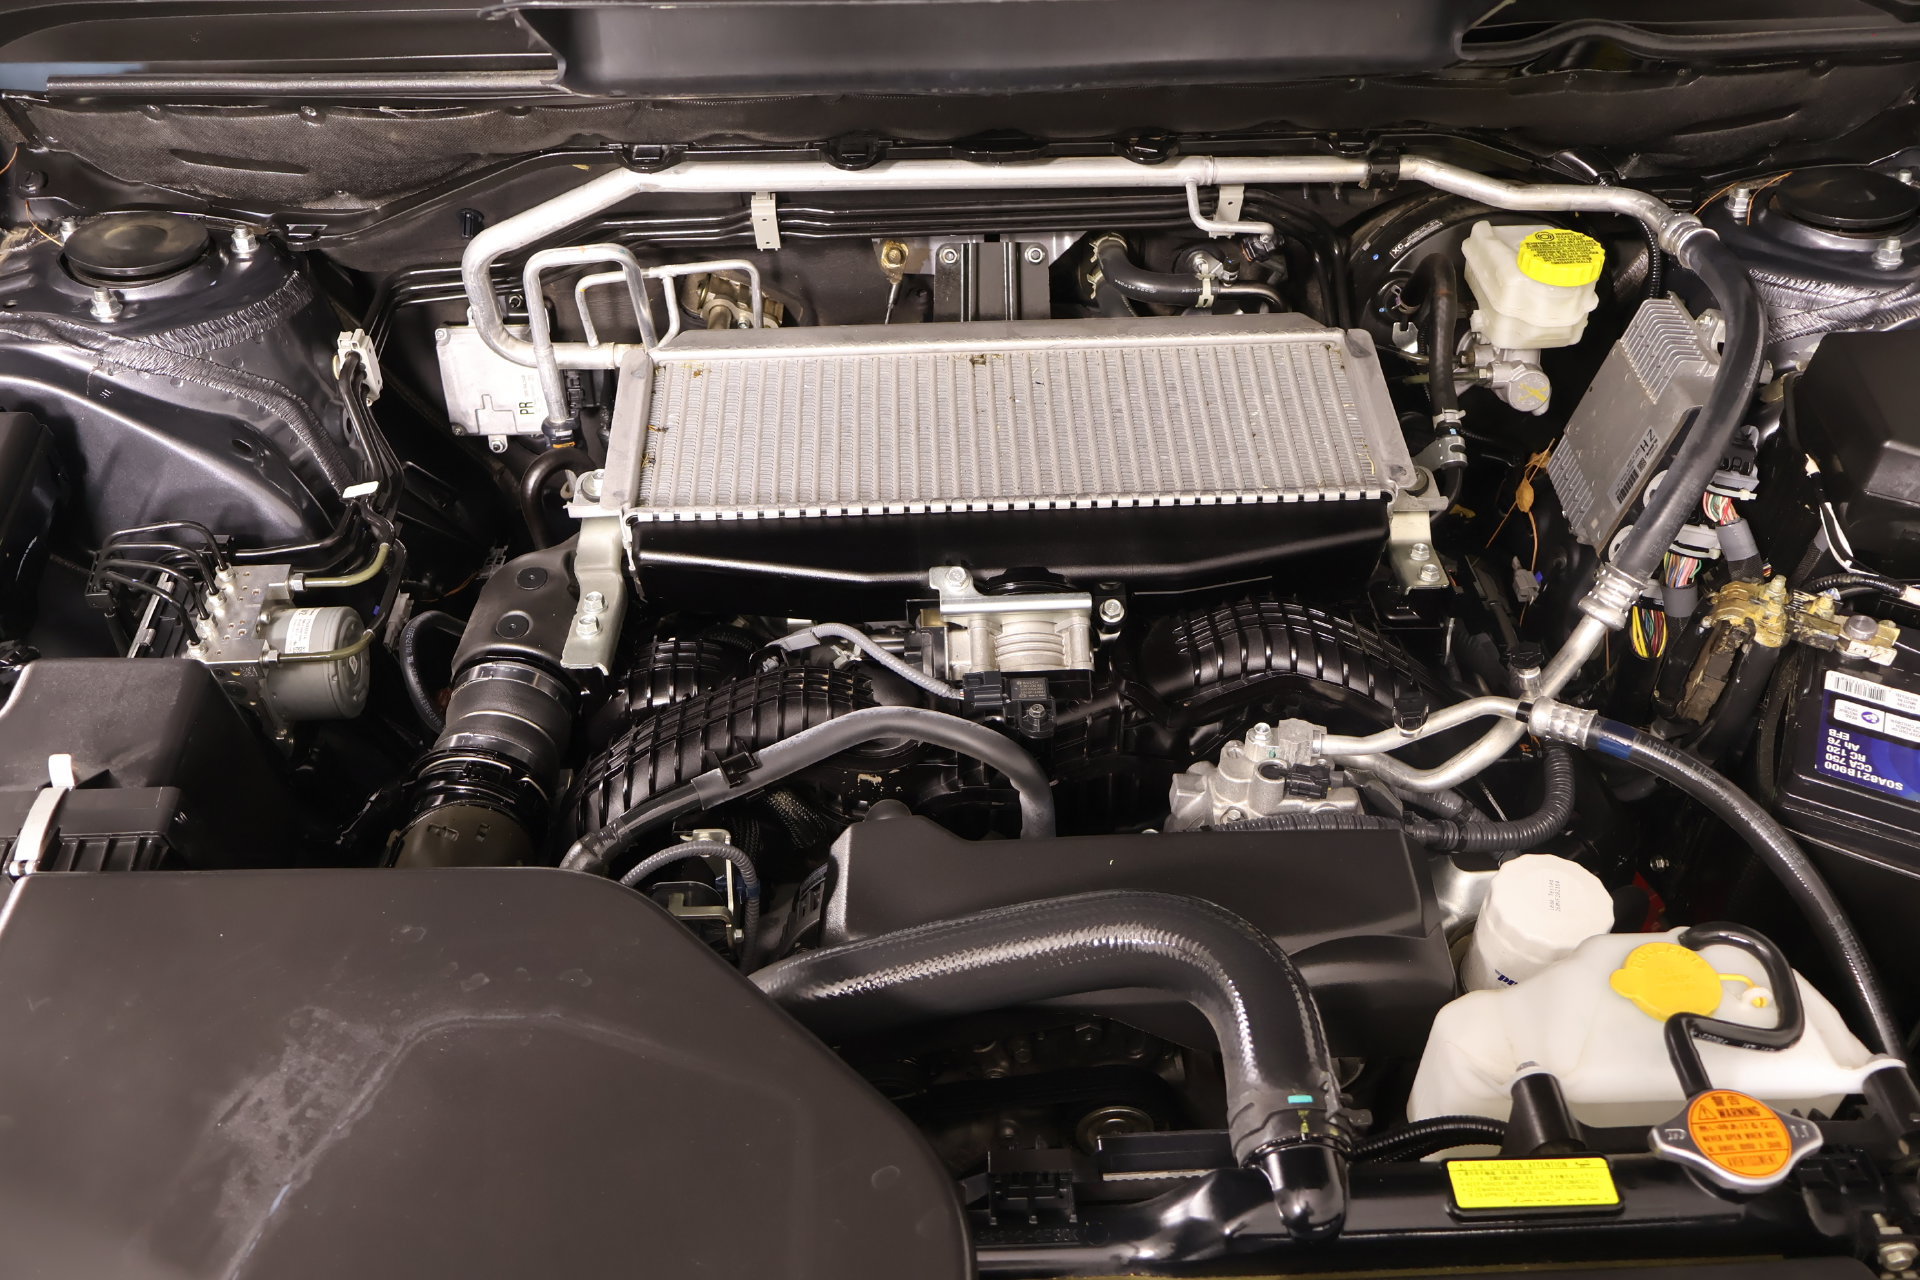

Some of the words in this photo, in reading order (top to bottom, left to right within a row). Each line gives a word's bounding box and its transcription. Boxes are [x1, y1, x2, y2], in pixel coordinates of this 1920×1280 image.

[519, 402, 534, 414] PR
[1829, 729, 1849, 741] EFB
[1826, 744, 1846, 756] 120
[1844, 741, 1859, 752] Ah
[1826, 753, 1846, 765] 750
[1849, 751, 1866, 762] RC
[1849, 759, 1872, 772] CCA
[1717, 1107, 1760, 1118] WARNING
